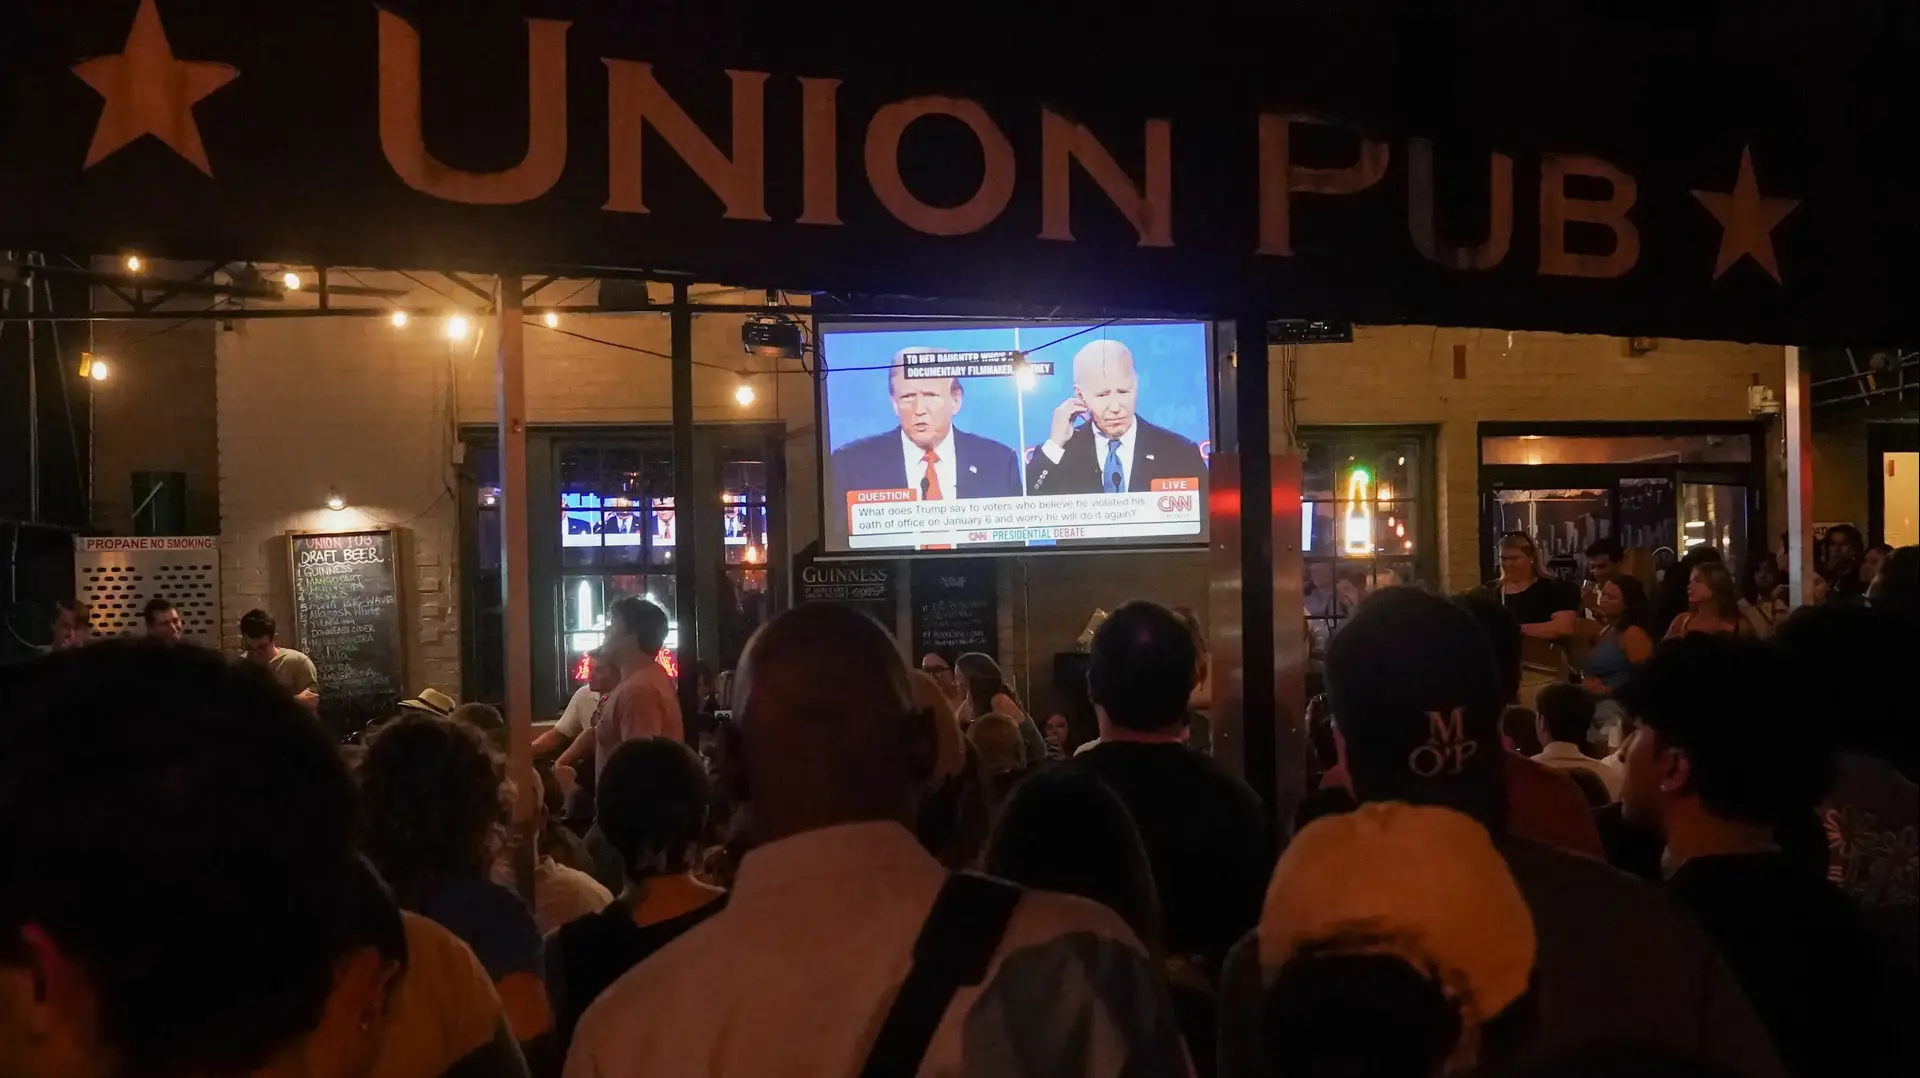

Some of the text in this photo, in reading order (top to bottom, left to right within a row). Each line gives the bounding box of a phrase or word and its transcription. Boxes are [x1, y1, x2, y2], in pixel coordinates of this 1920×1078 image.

[373, 4, 1640, 279] UNION PUB
[907, 355, 917, 364] TO
[919, 353, 935, 363] HER
[908, 365, 965, 377] DOCUMENTARY
[1162, 480, 1187, 490] LIVE
[857, 491, 910, 502] QUESTION
[858, 495, 1145, 517] What does Trump say to voters who believe he violated his
[1157, 495, 1192, 512] CNN
[859, 509, 1136, 530] oath of office on January 6 and worry he will do it again?
[968, 527, 1085, 541] CNN PRESIDENTIAL DEBATE
[87, 538, 212, 549] PROPANE NO SMOKING
[306, 537, 341, 549] UNION
[302, 547, 378, 564] DRAFT BEER
[304, 564, 353, 577] GUINNESS
[803, 566, 888, 583] GUINNESS
[367, 595, 394, 605] WAVE
